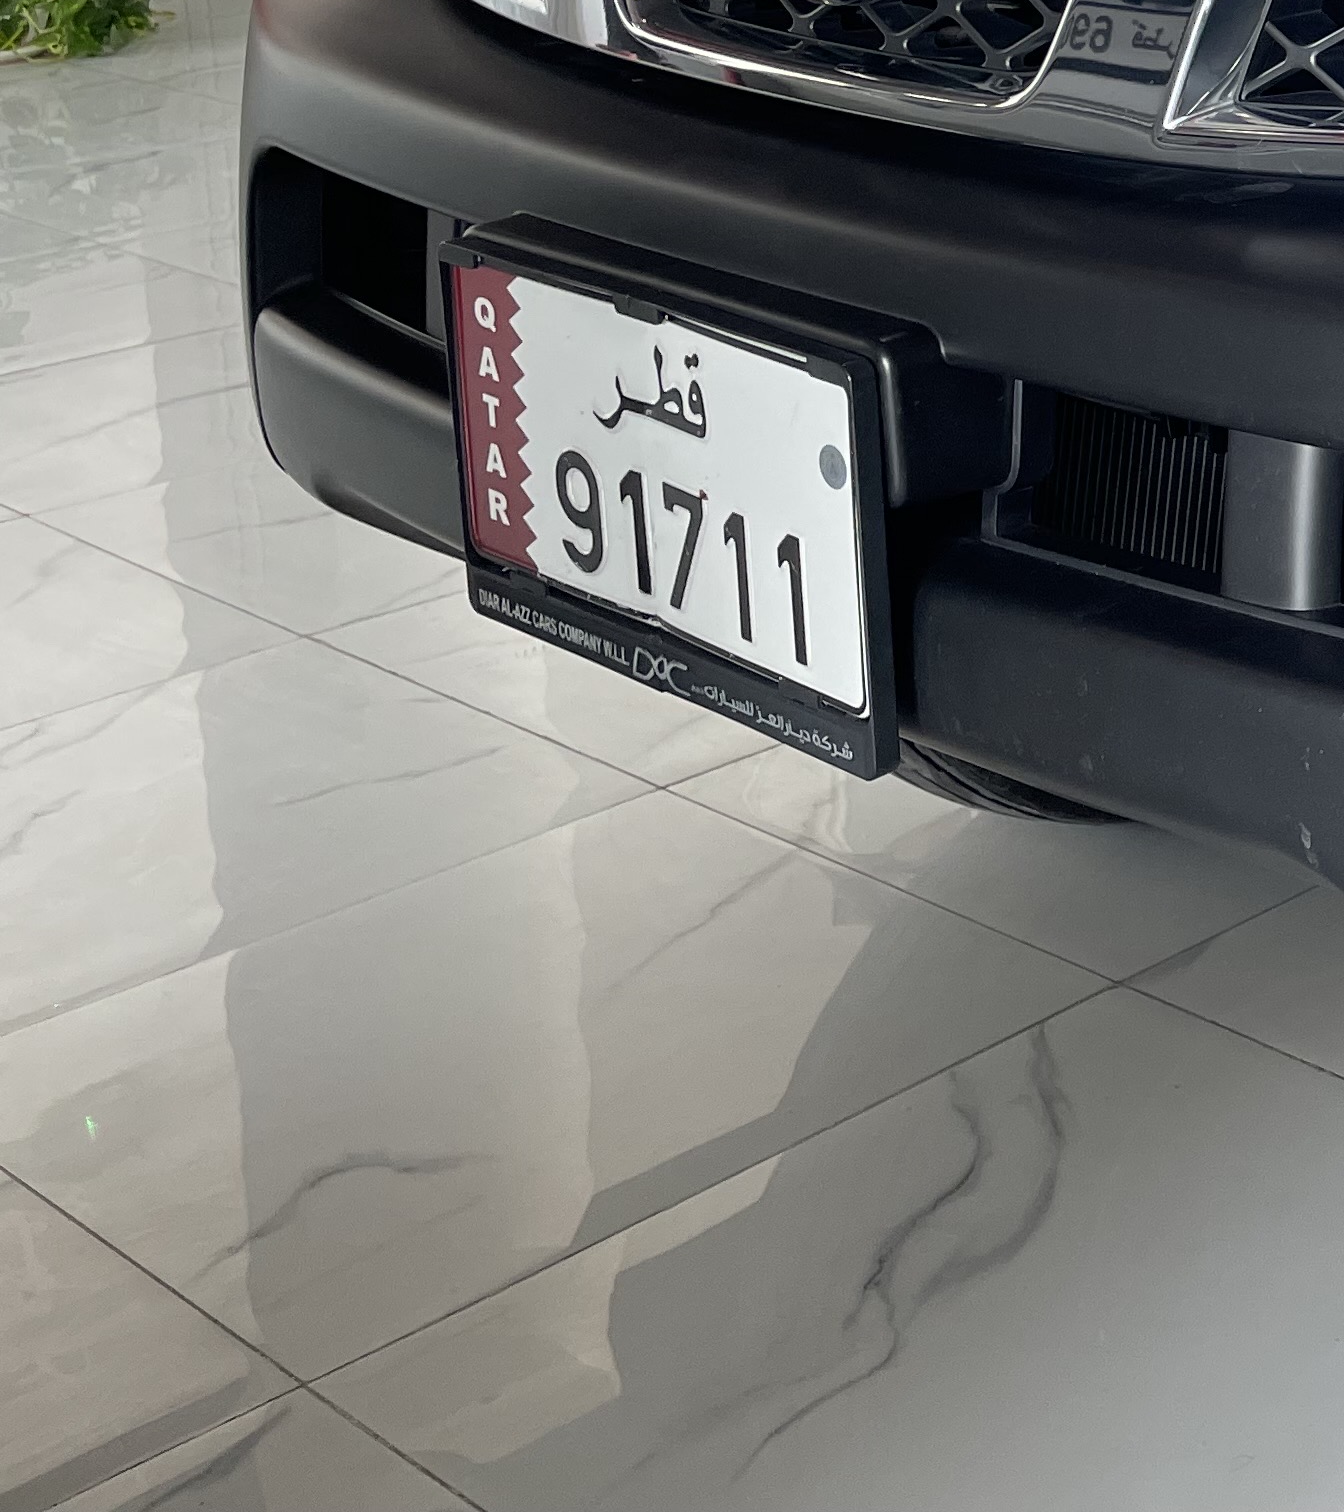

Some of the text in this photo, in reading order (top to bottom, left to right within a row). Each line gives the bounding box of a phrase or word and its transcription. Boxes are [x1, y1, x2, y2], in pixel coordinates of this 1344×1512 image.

[472, 295, 512, 529] QATAR
[593, 343, 708, 439] قطر
[554, 448, 809, 667] 91711
[478, 588, 500, 612] DIAR
[501, 597, 532, 627] AL-AZZ
[531, 611, 558, 637] CARS
[558, 621, 602, 655] COMPANY
[812, 728, 854, 761] شركة
